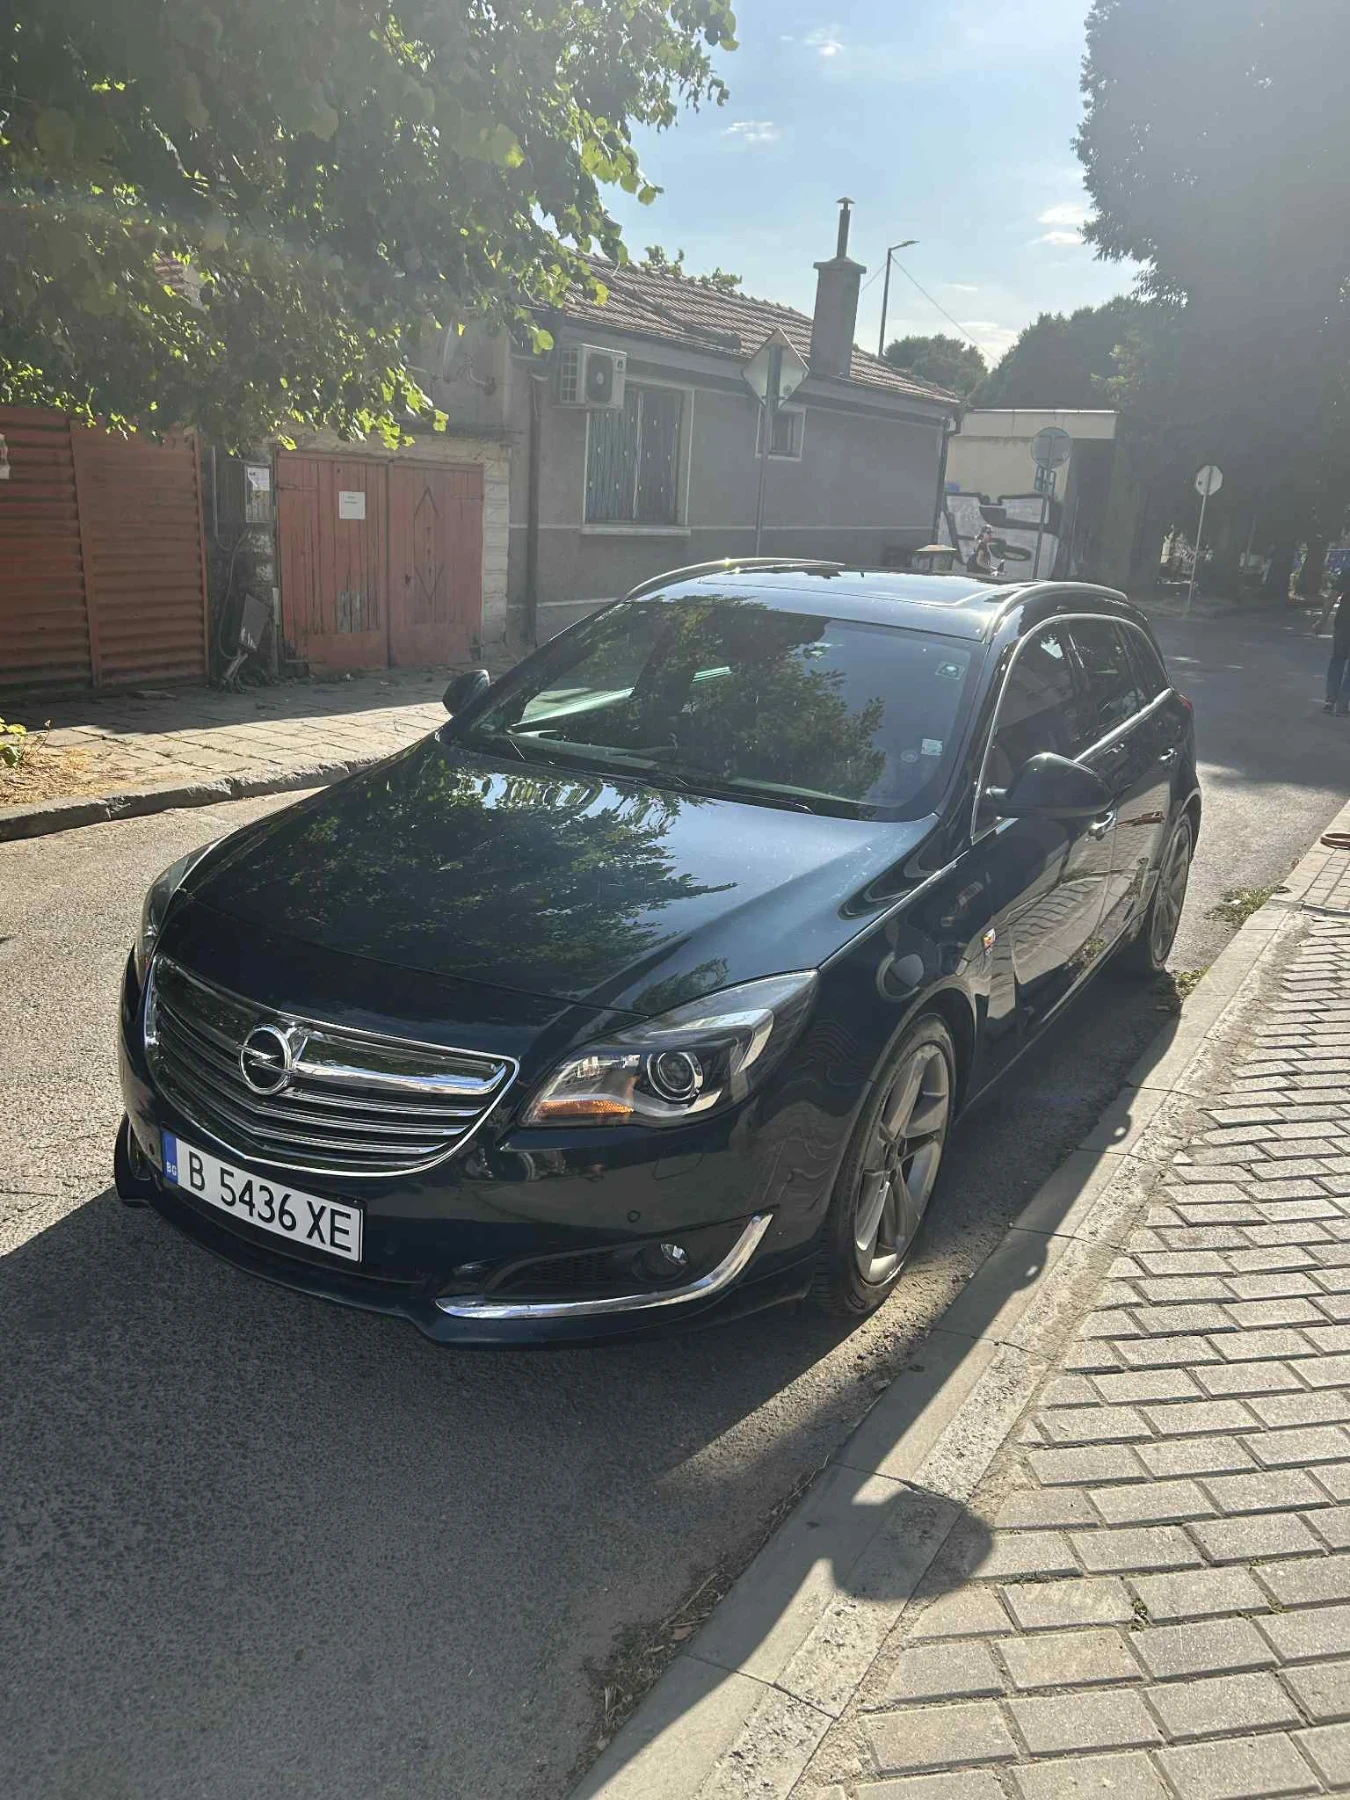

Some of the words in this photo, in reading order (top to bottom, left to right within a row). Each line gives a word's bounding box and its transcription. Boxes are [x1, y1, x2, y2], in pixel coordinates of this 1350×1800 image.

[166, 1160, 177, 1176] BG
[189, 1151, 205, 1191] B
[220, 1167, 297, 1231] 5436
[306, 1201, 352, 1252] XE
